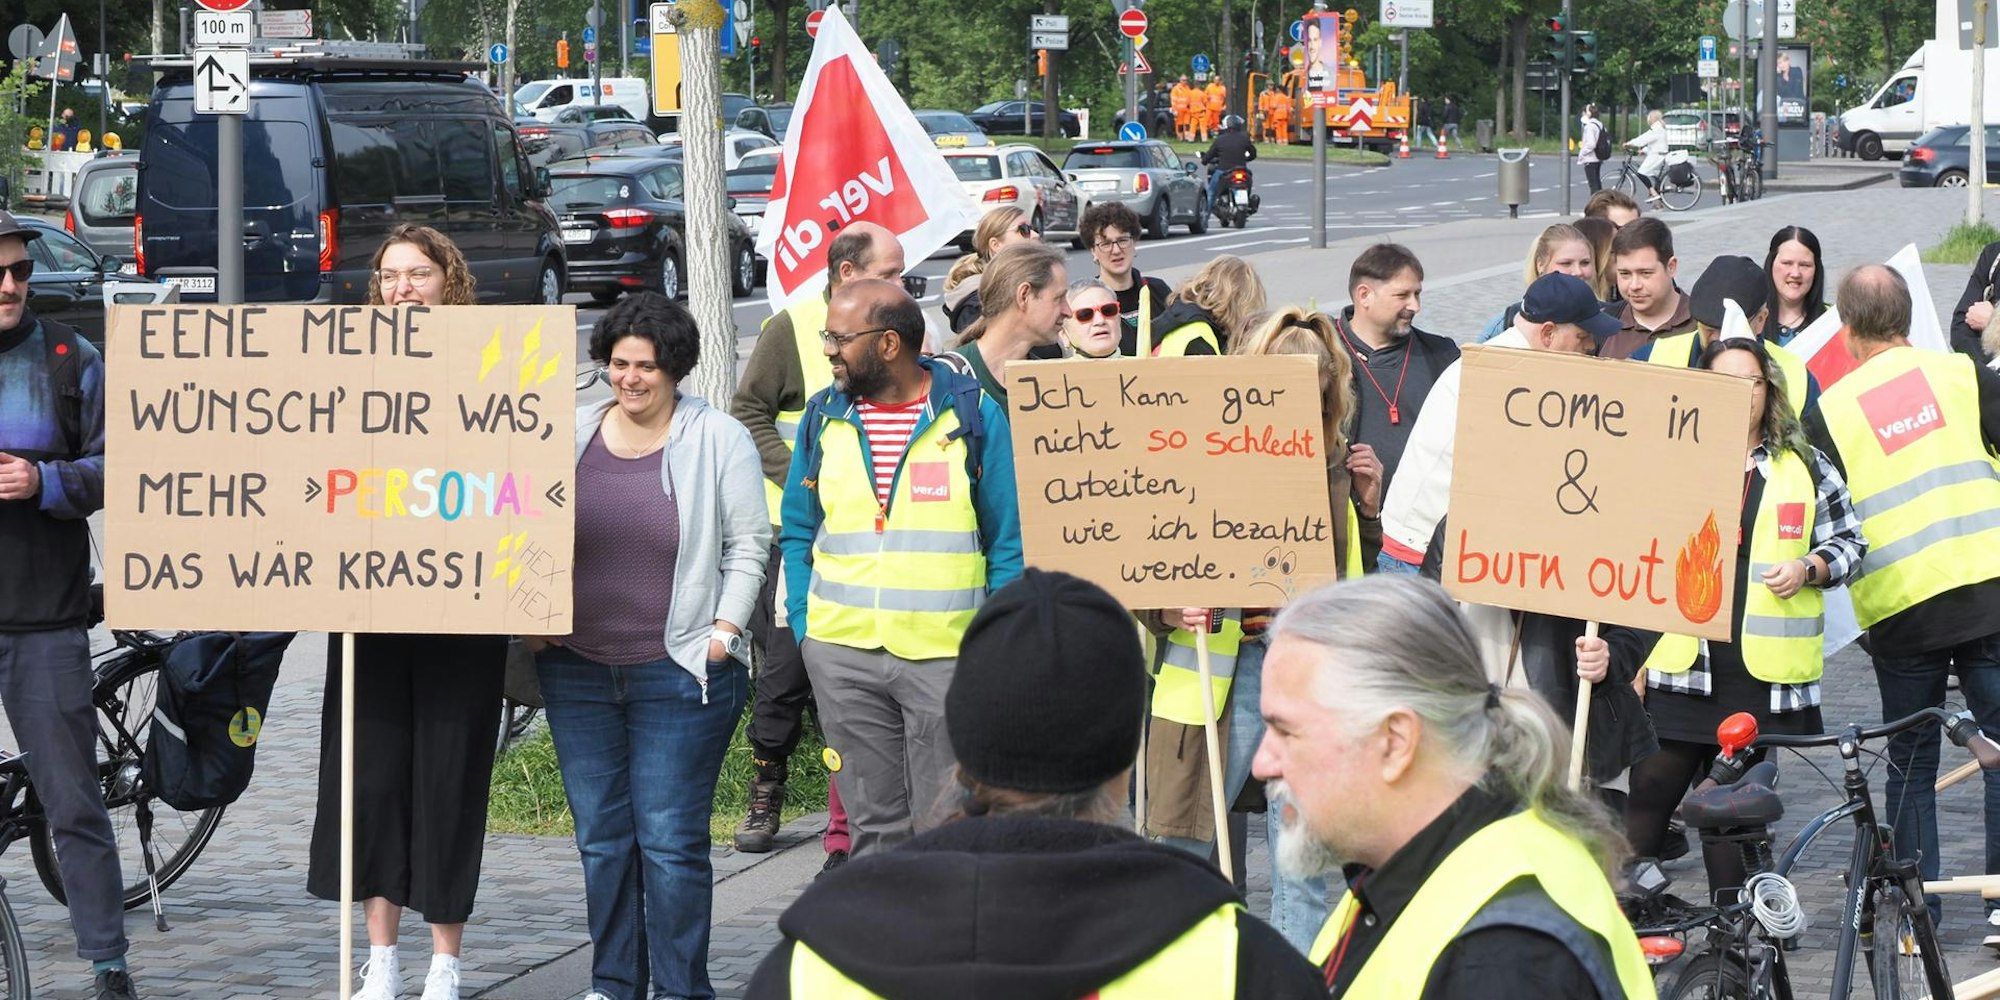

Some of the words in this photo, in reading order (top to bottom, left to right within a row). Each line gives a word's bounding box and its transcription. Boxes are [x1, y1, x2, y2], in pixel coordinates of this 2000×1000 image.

[202, 20, 226, 34] 100
[231, 22, 244, 34] m
[191, 278, 213, 288] 3112
[140, 307, 269, 359] EENE
[302, 306, 433, 358] MENE
[131, 382, 346, 435] WÜNSCH'
[362, 391, 431, 435] DIR
[458, 393, 554, 440] WAS,
[1222, 387, 1286, 425] gar
[1667, 394, 1701, 444] in
[1878, 403, 1939, 440] ver.di
[1033, 420, 1121, 456] nicht
[1147, 430, 1188, 452] so
[138, 472, 267, 517] MEHR
[911, 485, 948, 497] ver.di
[1556, 449, 1600, 515] &
[1063, 518, 1121, 544] wie
[1146, 512, 1198, 541] ich
[1212, 509, 1329, 544] bezahlt
[125, 552, 203, 591] DAS
[228, 541, 313, 588] WÄR
[339, 548, 483, 601] KRASS!
[520, 541, 566, 586] HEX
[1120, 554, 1236, 583] werde.
[1457, 529, 1566, 591] burn
[1588, 537, 1668, 605] out
[510, 580, 564, 630] HEX
